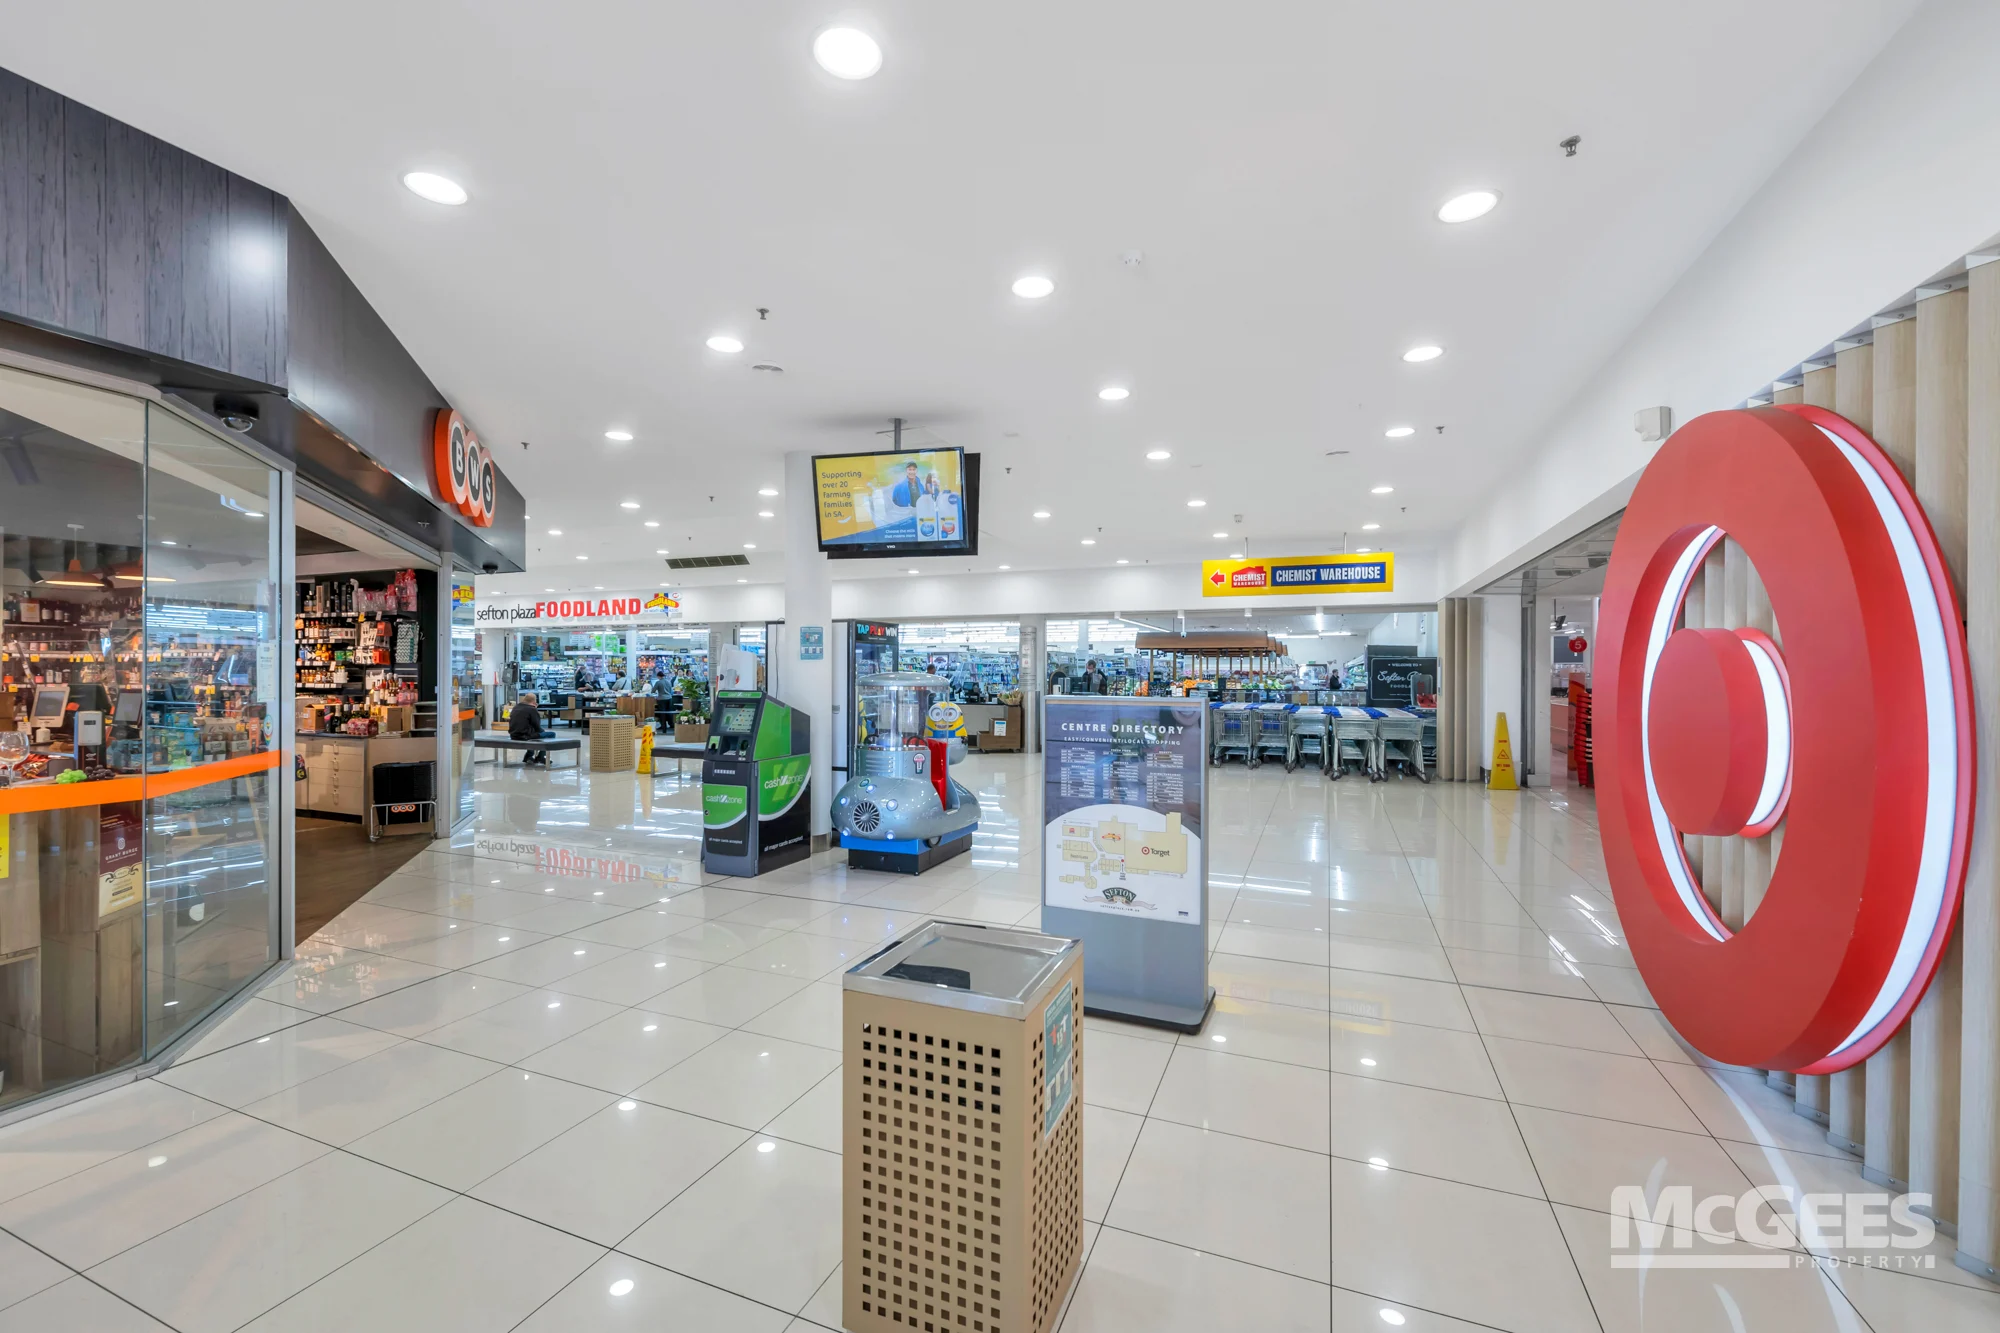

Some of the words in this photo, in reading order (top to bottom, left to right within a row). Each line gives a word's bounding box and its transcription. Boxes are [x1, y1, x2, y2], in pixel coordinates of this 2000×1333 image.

[822, 471, 862, 479] Supporting
[1233, 573, 1266, 582] CHEMIST
[1276, 568, 1317, 582] CHEMIST
[1320, 566, 1380, 580] WAREHOUSE
[476, 604, 509, 620] sefton
[511, 604, 536, 623] plaza
[536, 598, 641, 618] FOODLAND
[857, 624, 869, 635] TAP
[870, 625, 885, 636] PLAY
[885, 626, 897, 637] WIN
[1575, 640, 1582, 649] 5
[1062, 723, 1106, 732] CENTRE
[1112, 724, 1184, 734] DIRECTORY
[1150, 848, 1170, 857] Target
[1104, 888, 1134, 902] SEFTON
